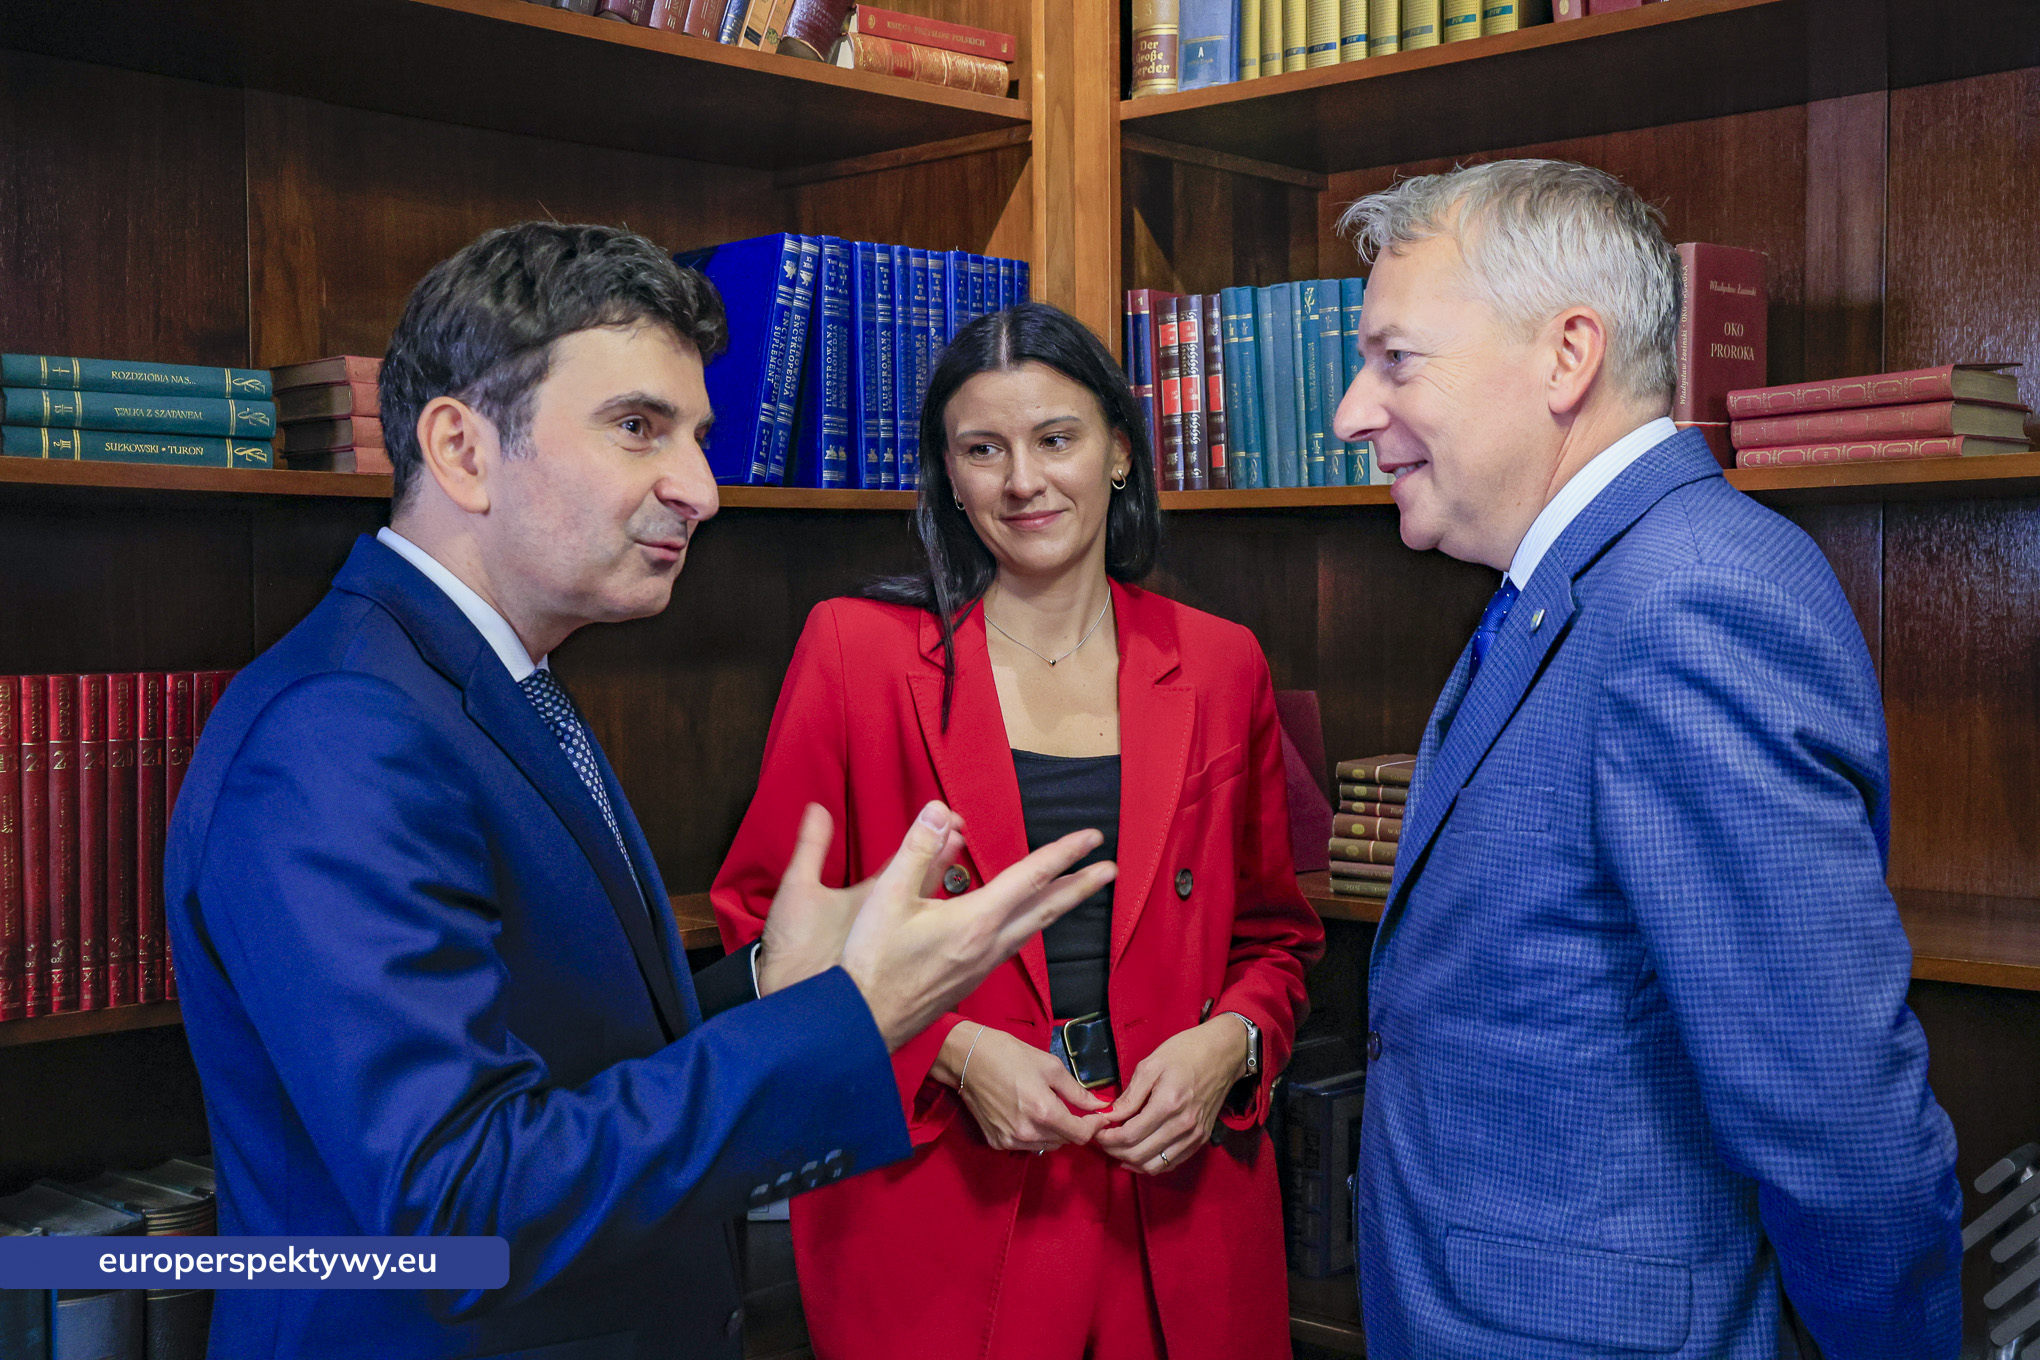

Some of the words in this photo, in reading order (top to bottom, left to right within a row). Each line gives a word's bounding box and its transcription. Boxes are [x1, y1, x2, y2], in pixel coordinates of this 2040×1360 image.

[952, 33, 986, 47] POLSKICH
[1140, 40, 1159, 50] Der
[1198, 47, 1204, 58] A
[1723, 321, 1744, 337] OKO
[767, 325, 781, 384] SUPLEMENT
[783, 314, 801, 396] ENCYKLOPEDJA
[789, 315, 807, 398] ILUSTROWANA
[1711, 343, 1755, 361] PROROKA
[1680, 364, 1689, 405] Władysław
[114, 407, 145, 417] WALKA
[146, 408, 153, 417] Z
[154, 409, 203, 420] SZATANEM
[105, 442, 159, 453] SUŁKOWSKI
[59, 681, 70, 737] OXFORD
[118, 681, 129, 736] OXFORD
[142, 747, 162, 766] 21
